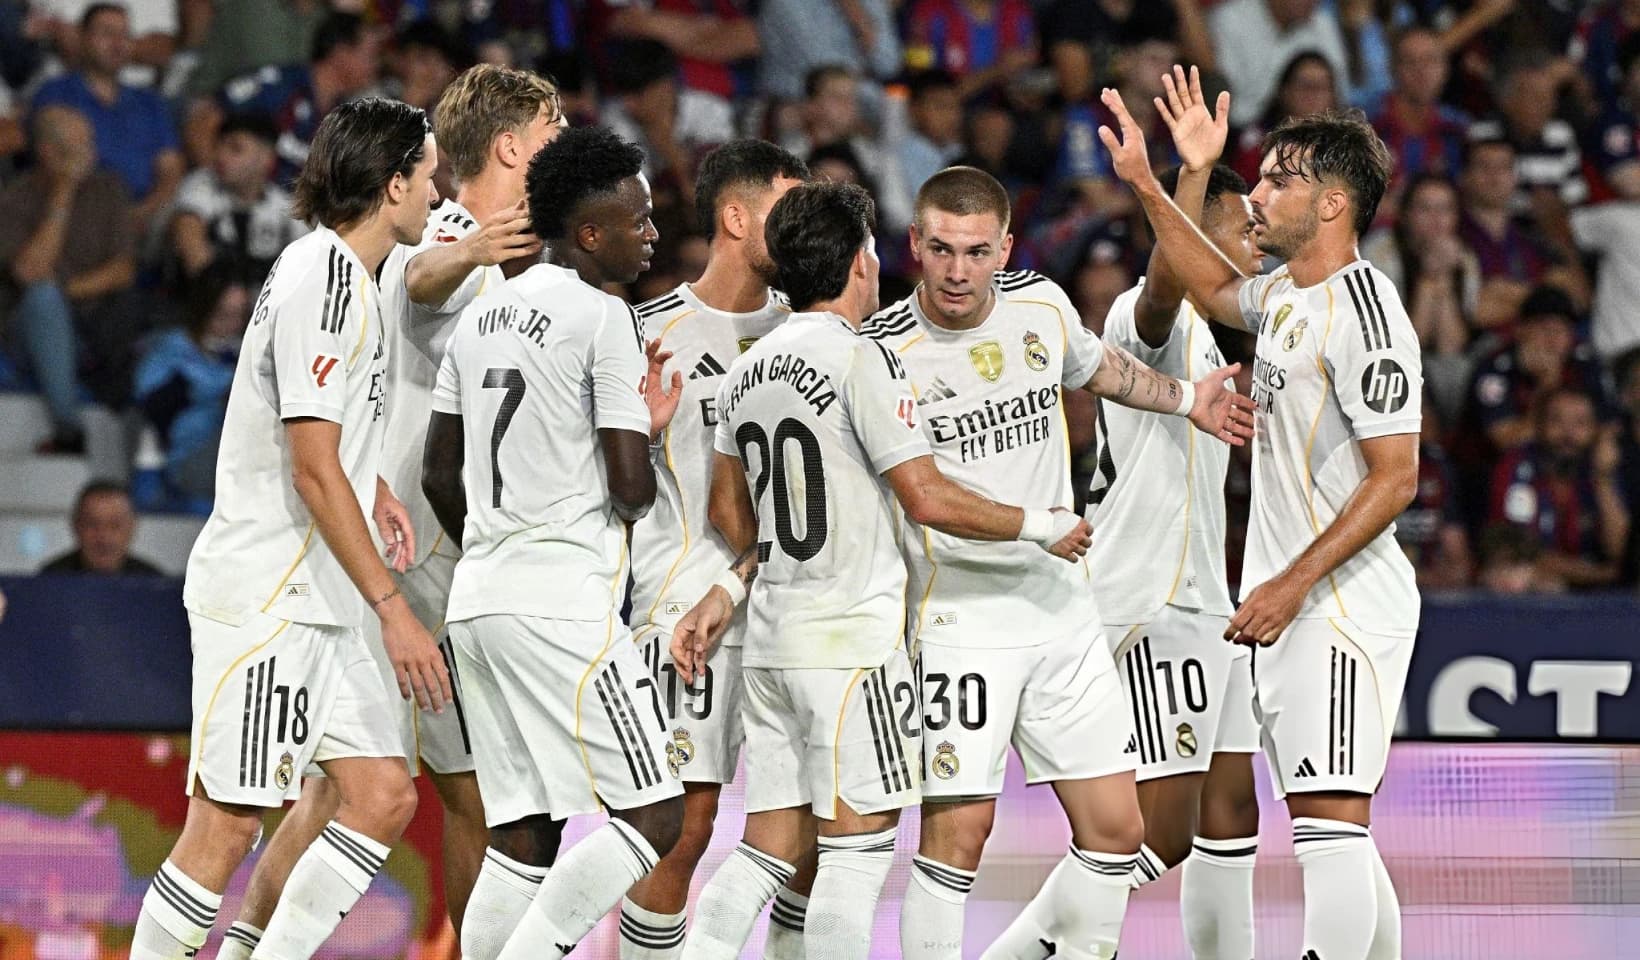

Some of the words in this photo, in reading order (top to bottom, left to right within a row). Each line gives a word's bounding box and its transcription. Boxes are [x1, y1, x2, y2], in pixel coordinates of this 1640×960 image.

[518, 308, 552, 349] JR.
[768, 354, 837, 417] GARCÍA
[928, 383, 1059, 444] Emirates
[1367, 359, 1403, 414] hp
[481, 367, 527, 509] 7
[960, 434, 987, 464] FLY
[994, 415, 1050, 454] BETTER
[735, 417, 828, 562] 20
[273, 685, 309, 745] 18
[636, 677, 667, 732] 7
[660, 663, 714, 721] 19
[924, 672, 987, 731] 30
[1155, 658, 1208, 715] 10
[1392, 655, 1633, 737] ST
